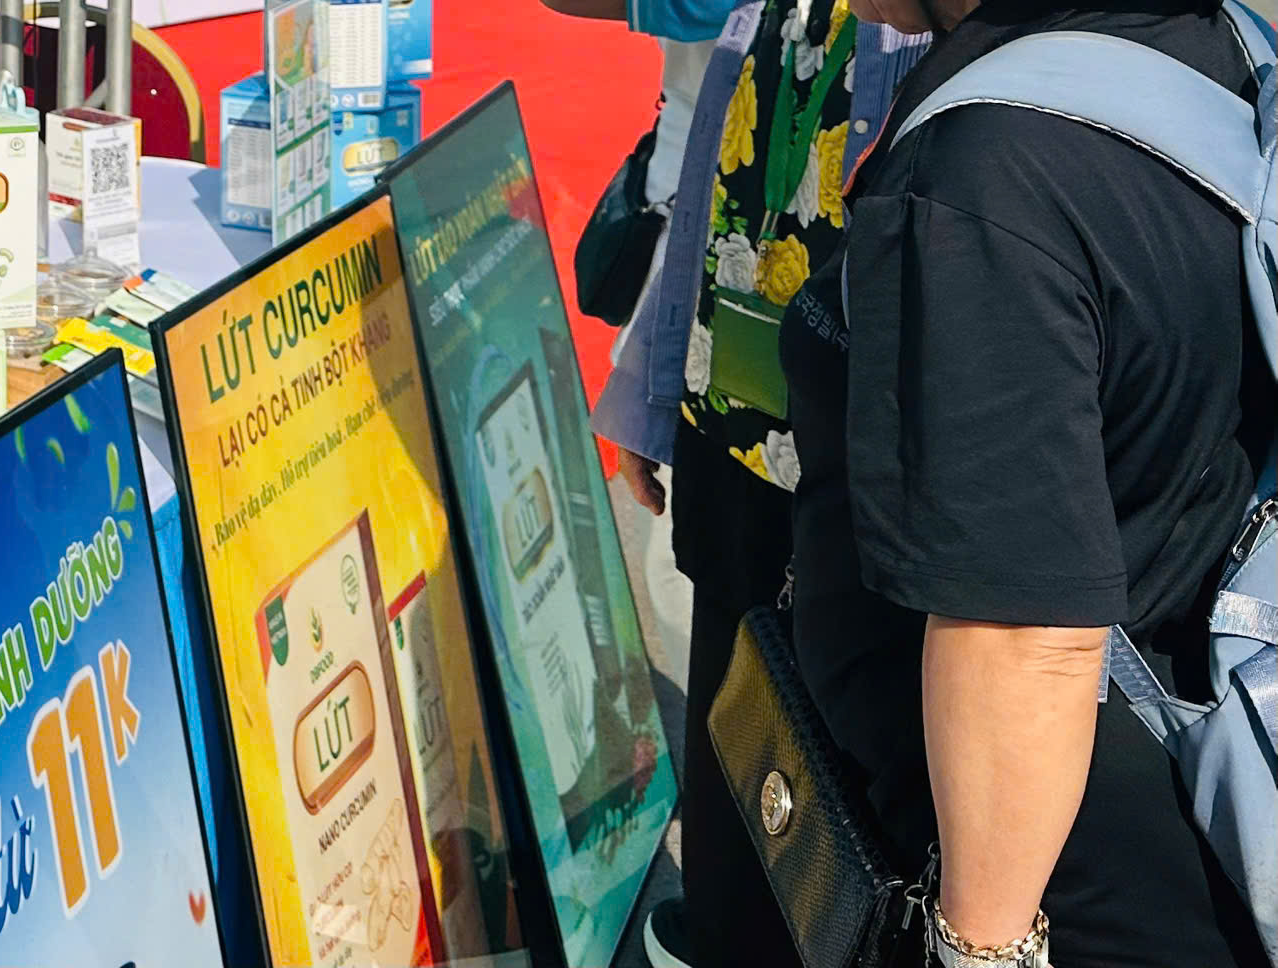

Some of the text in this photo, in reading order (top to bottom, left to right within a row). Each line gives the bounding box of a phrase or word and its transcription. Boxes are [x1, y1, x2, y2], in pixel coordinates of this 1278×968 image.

[201, 309, 256, 405] LỨT
[263, 234, 383, 360] CURCUMIN
[218, 420, 245, 469] LẠI
[246, 394, 269, 446] CÓ
[270, 374, 294, 427] CẢ
[291, 361, 323, 411] TINH
[323, 339, 350, 389] BỘT
[29, 516, 123, 671] DƯỠNG
[27, 639, 140, 918] 11K
[317, 818, 340, 855] NANO
